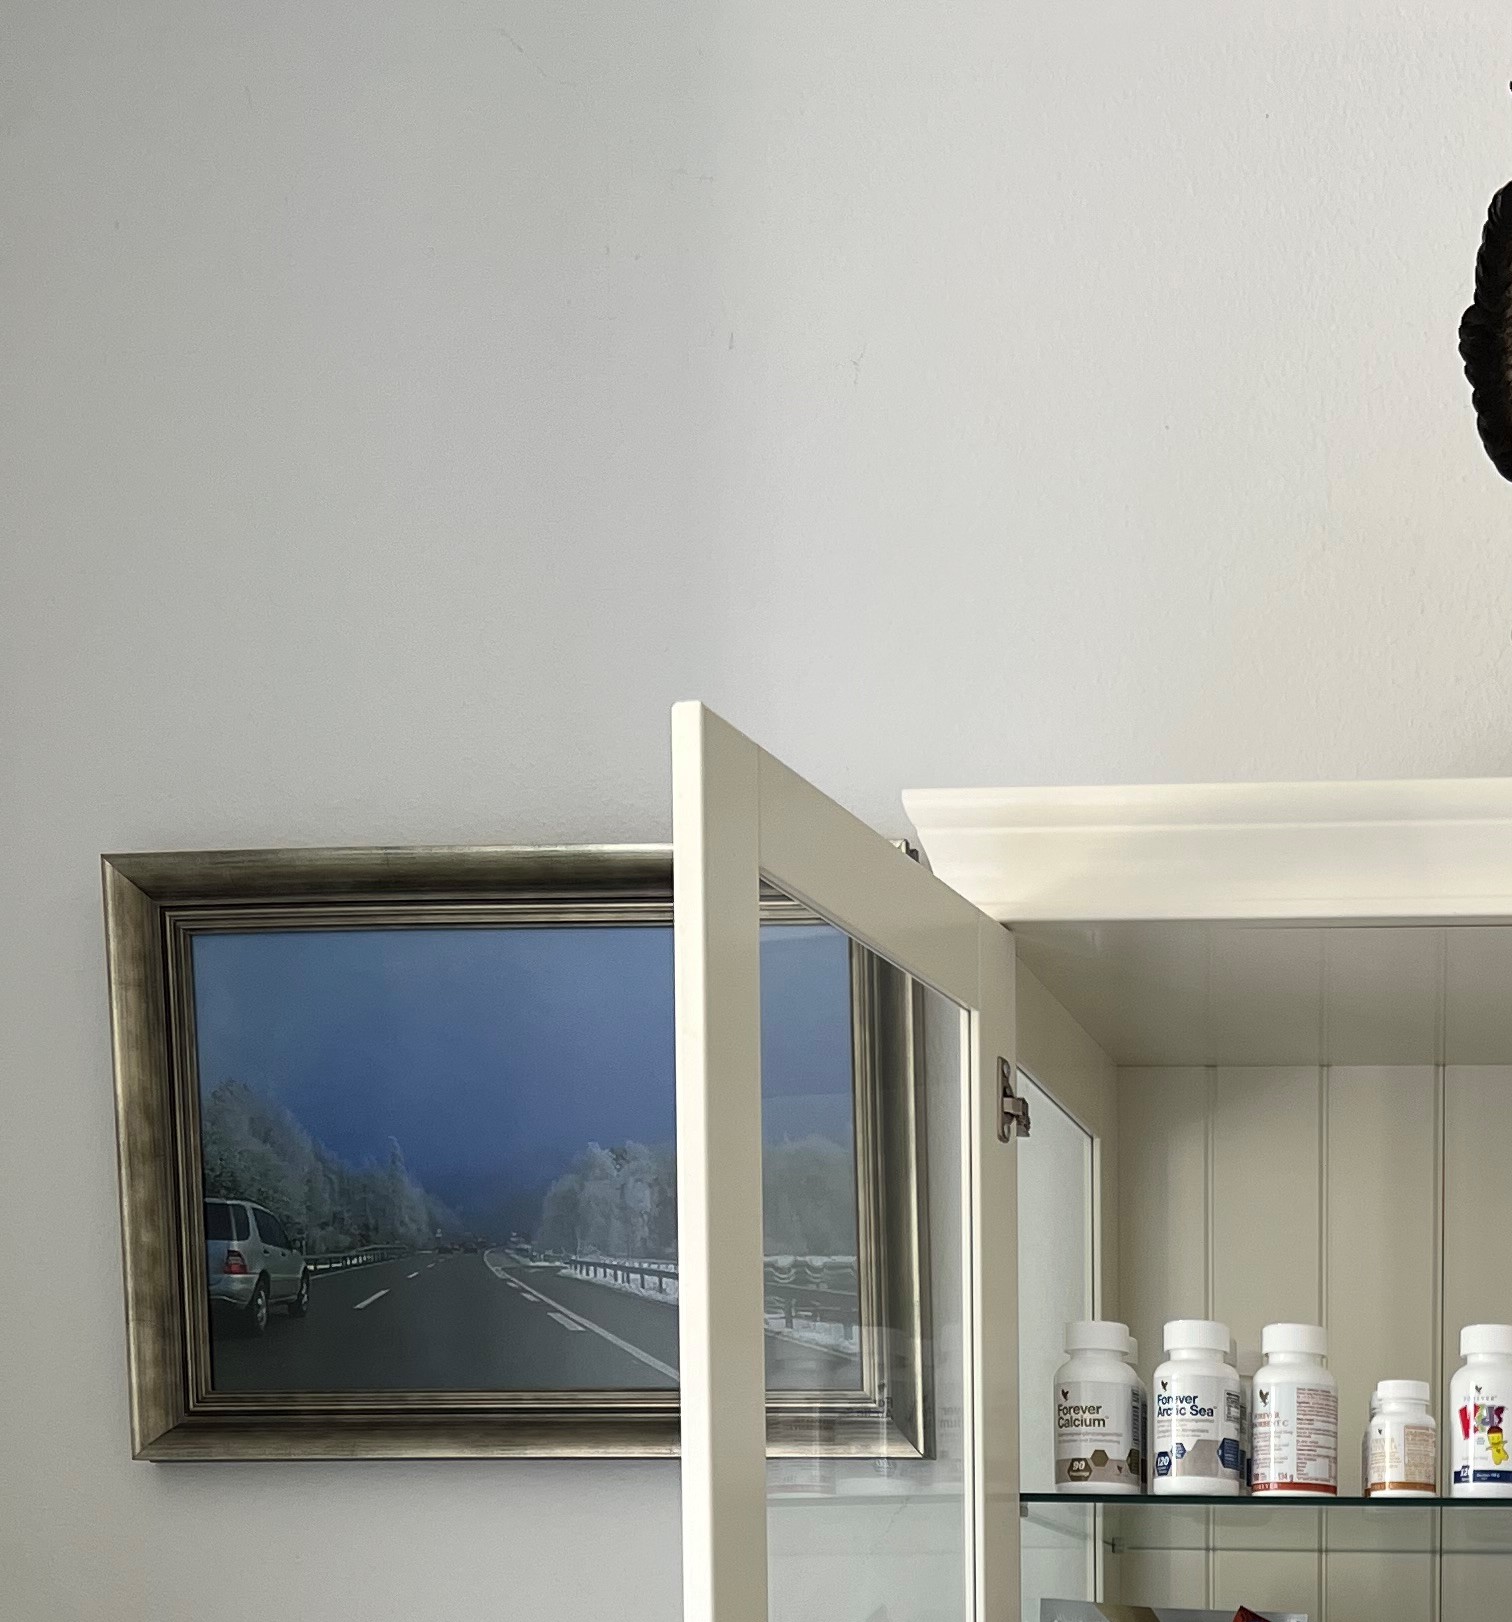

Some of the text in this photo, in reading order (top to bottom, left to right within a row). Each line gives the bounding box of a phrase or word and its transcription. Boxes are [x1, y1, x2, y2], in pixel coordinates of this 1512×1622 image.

[1058, 1404, 1102, 1416] Forever
[1190, 1405, 1214, 1417] Sea
[1058, 1416, 1106, 1428] Calcium
[1072, 1460, 1086, 1470] 90
